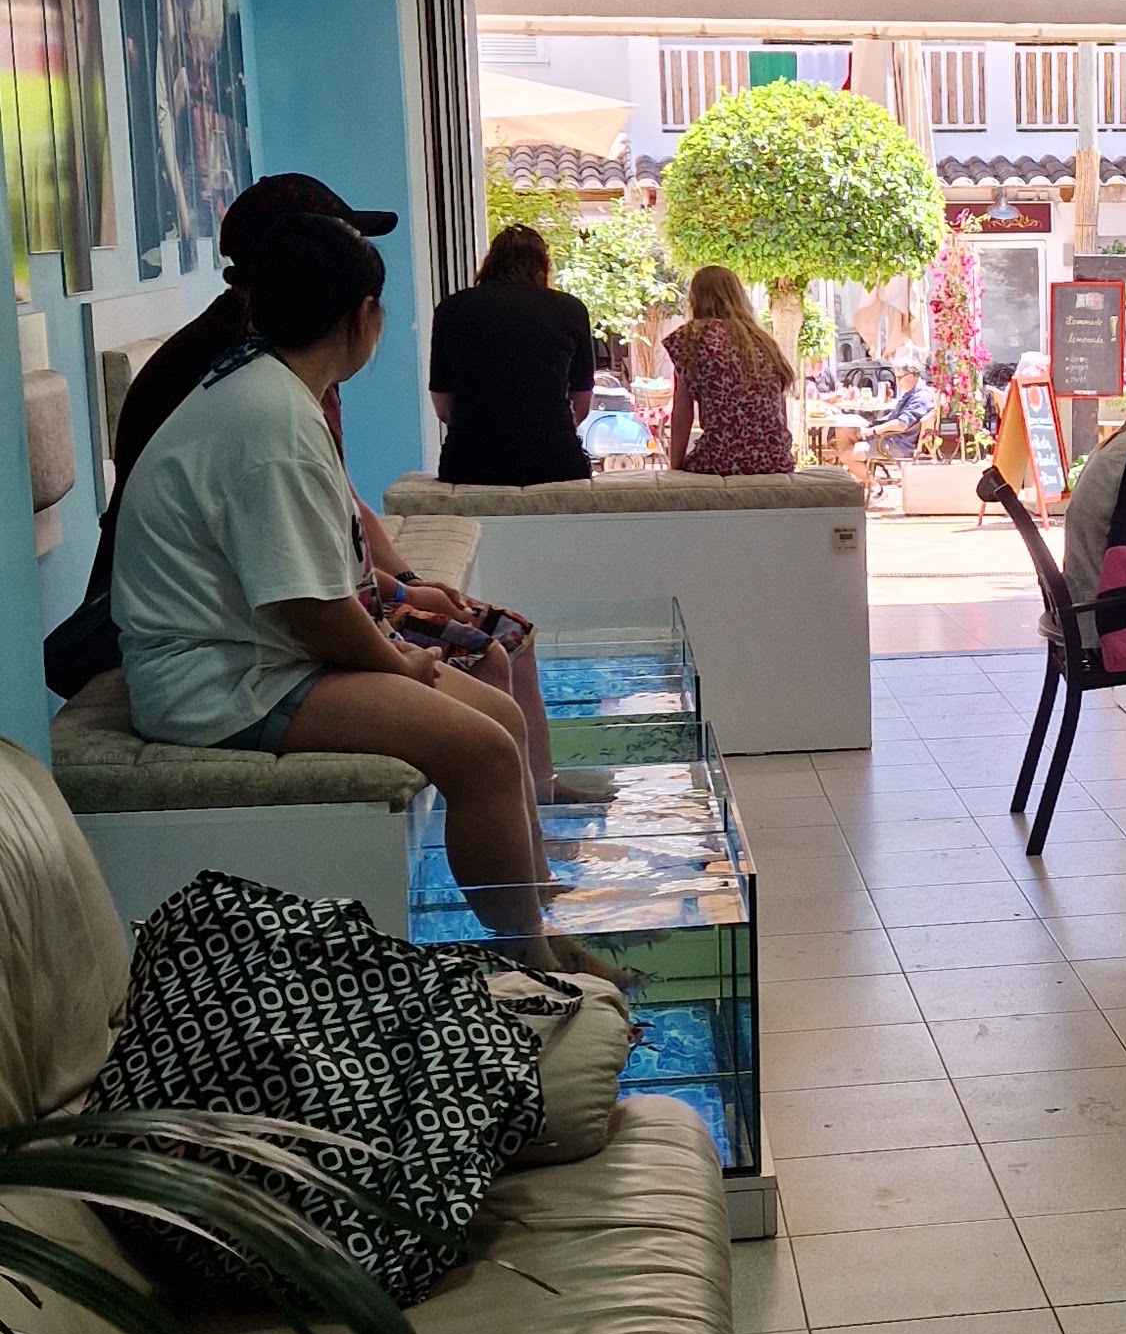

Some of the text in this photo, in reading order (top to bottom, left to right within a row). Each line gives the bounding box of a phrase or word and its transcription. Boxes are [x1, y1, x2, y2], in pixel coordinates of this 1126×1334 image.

[154, 958, 194, 1020] ONLY
[177, 1021, 224, 1093] ONLY
[179, 946, 253, 1082] ONLY ONLY
[206, 933, 249, 995] ONLY
[231, 995, 280, 1071] ONLY
[230, 919, 276, 985] ONLY
[258, 987, 308, 1061] ONLY
[310, 978, 355, 1057] ONLY
[339, 1058, 388, 1134] ONLY
[337, 974, 381, 1049] ONLY
[285, 982, 330, 1054] ONLY
[315, 1060, 363, 1138] ONLY
[417, 1029, 458, 1105] ONLY
[441, 1025, 484, 1102] ONLY
